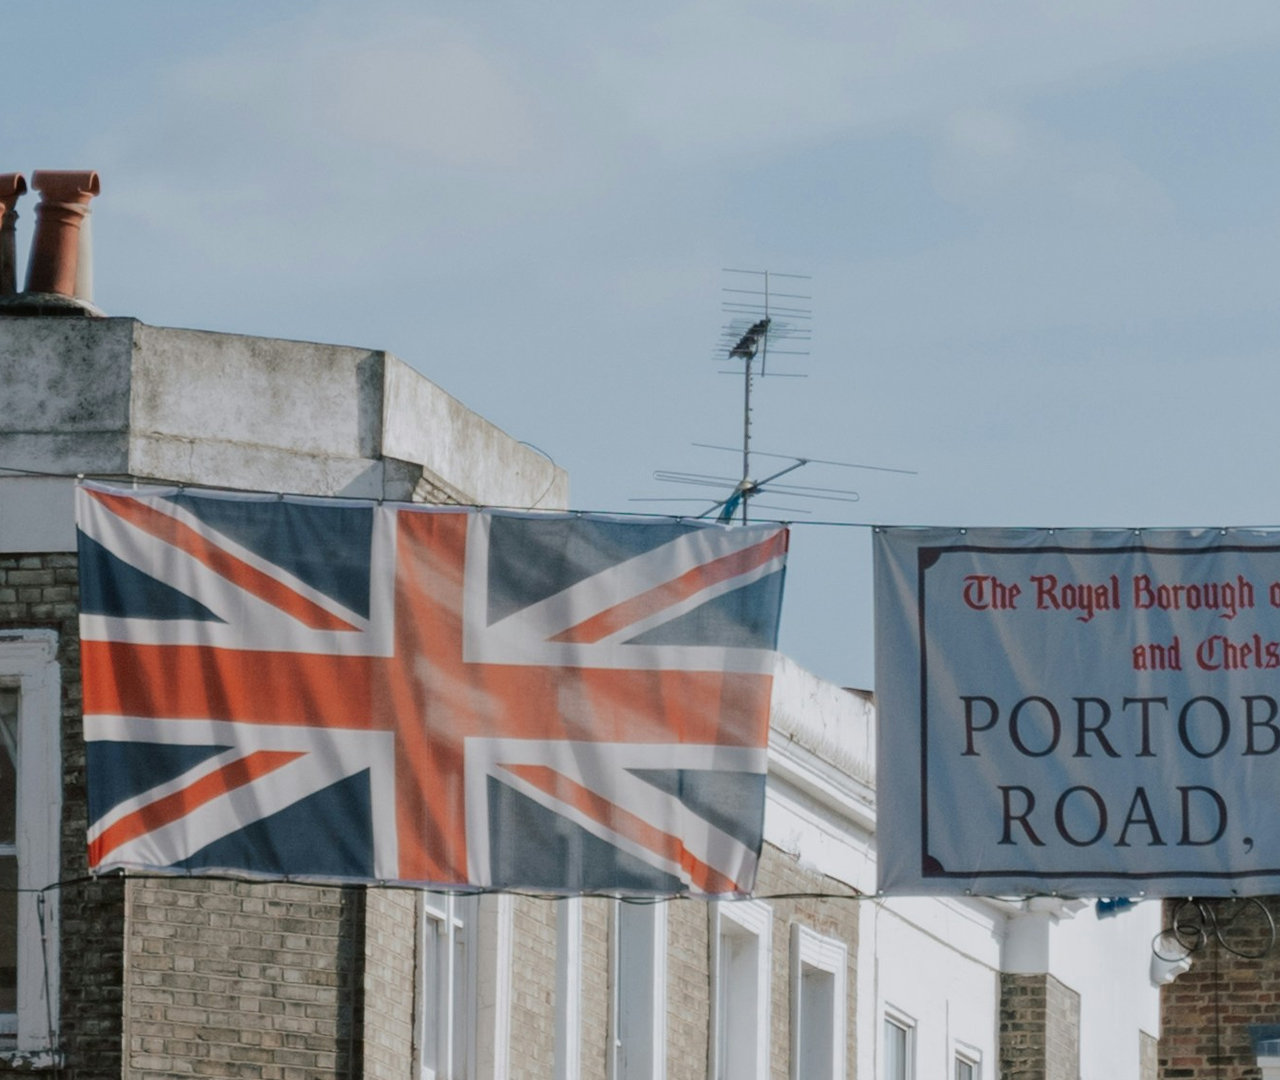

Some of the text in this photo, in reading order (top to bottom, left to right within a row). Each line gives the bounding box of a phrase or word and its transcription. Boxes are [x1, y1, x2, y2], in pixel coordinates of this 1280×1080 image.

[963, 574, 1021, 611] The
[1030, 574, 1120, 623] Royal
[1133, 574, 1254, 620] Borough
[1132, 635, 1182, 671] and
[996, 785, 1254, 853] ROAD,
